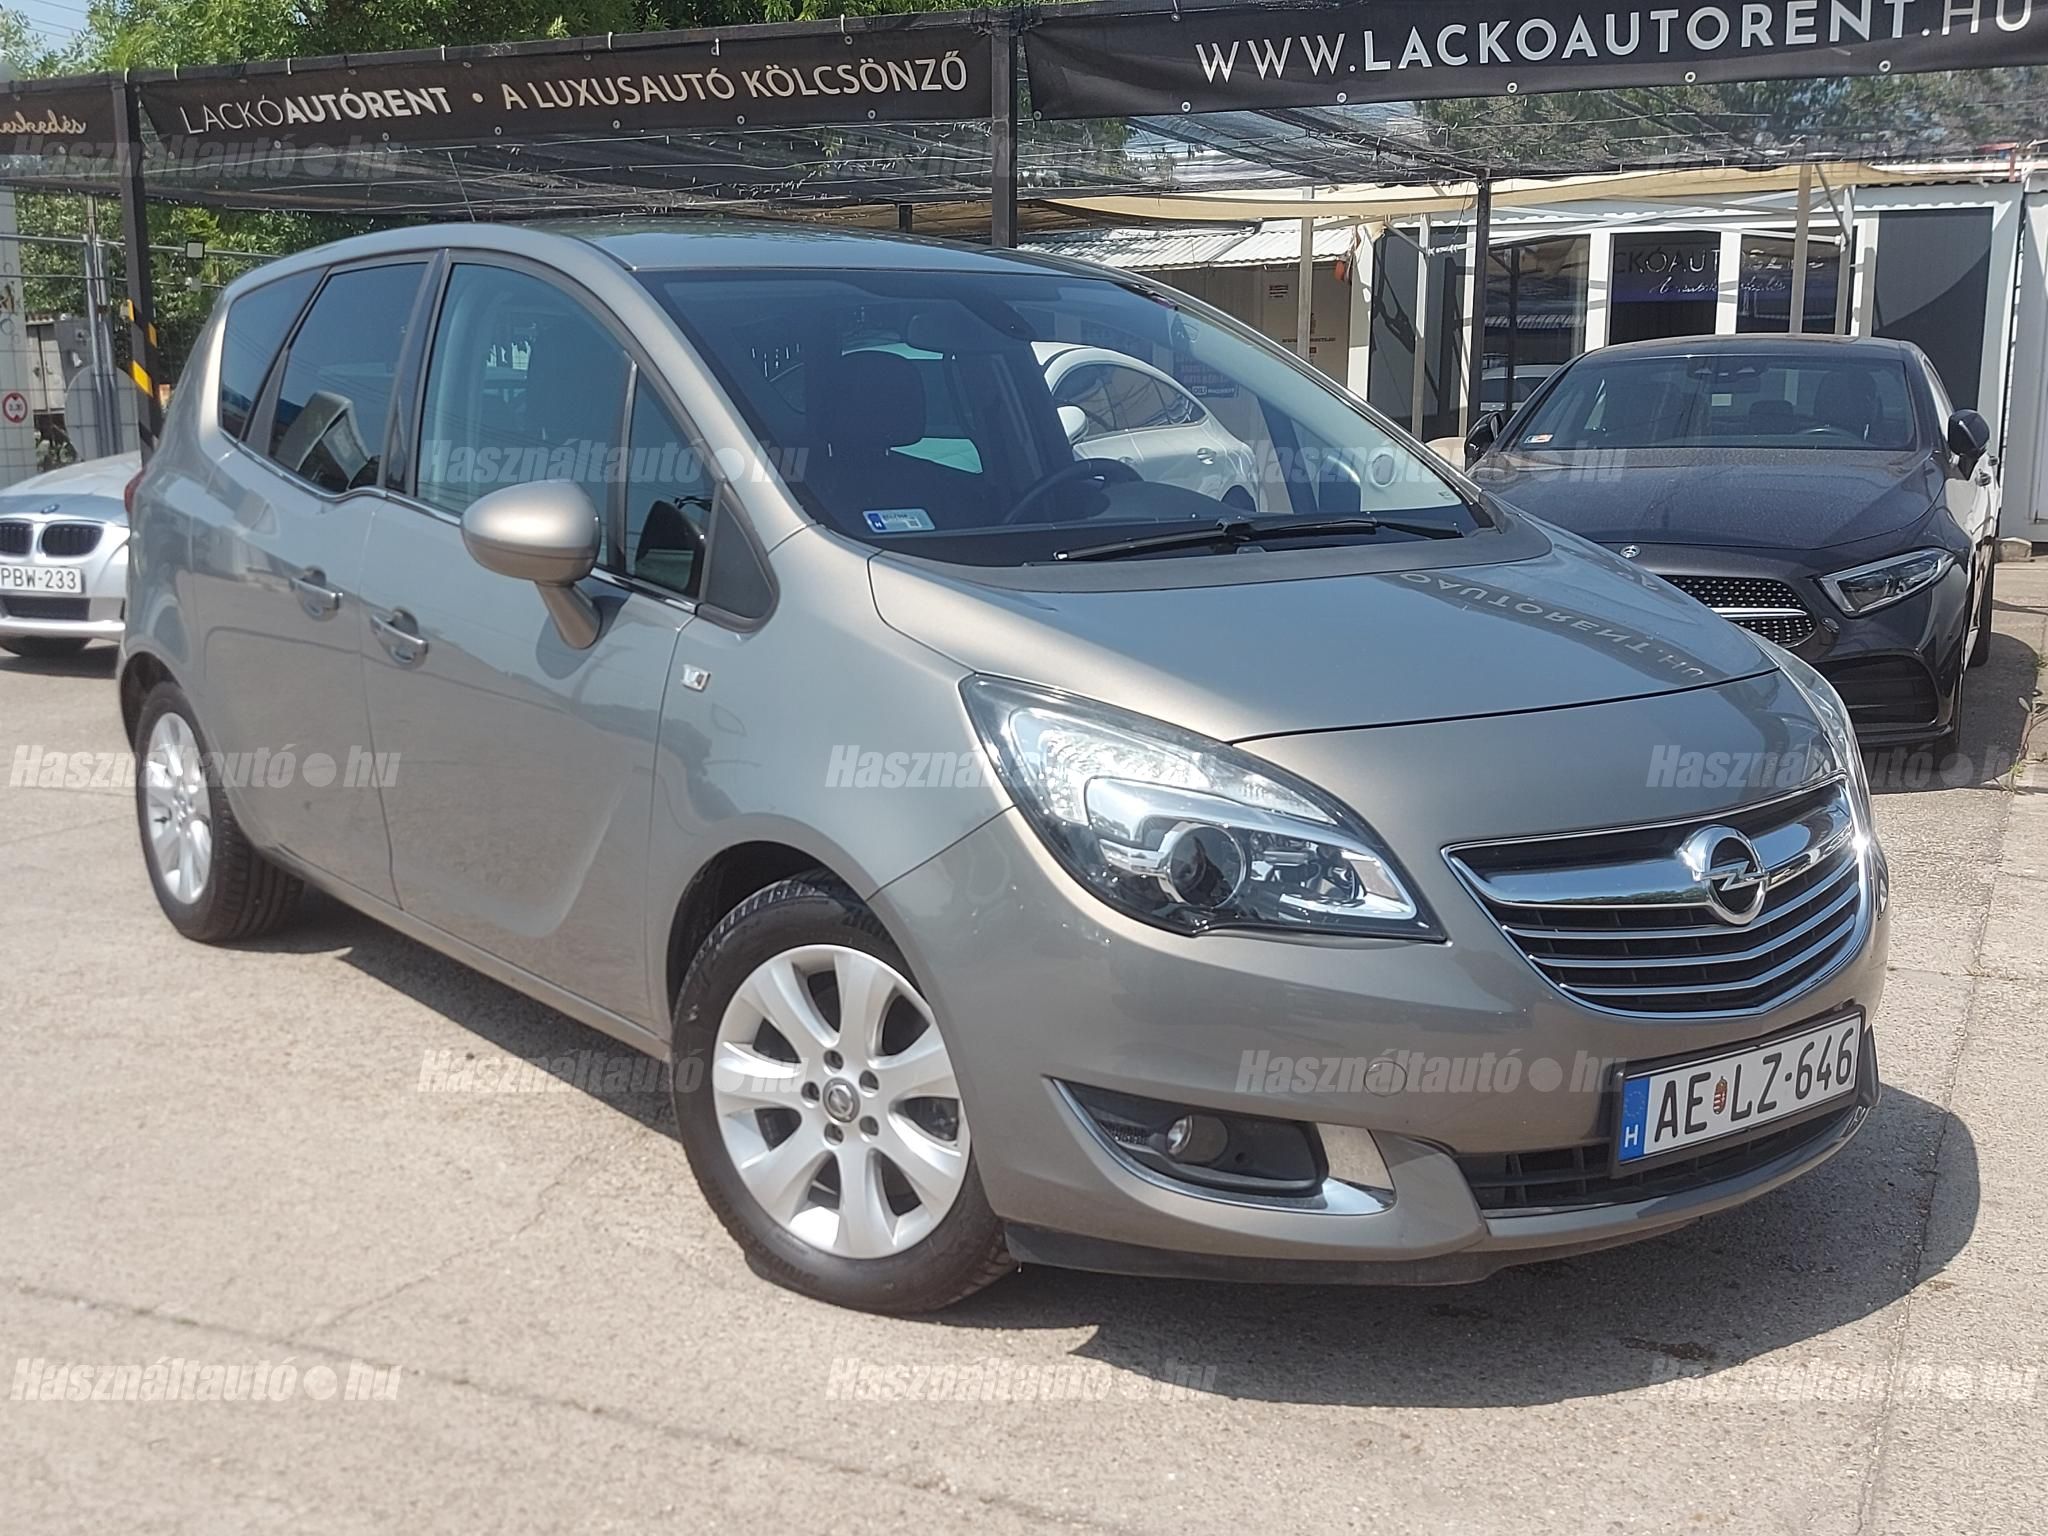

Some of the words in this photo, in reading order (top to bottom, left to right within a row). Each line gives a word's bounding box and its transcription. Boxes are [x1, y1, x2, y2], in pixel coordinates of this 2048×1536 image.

[1196, 0, 2032, 85] WWW.LACKOAUTORENT.HU
[179, 87, 452, 135] LACKÓAUTÓRENT
[501, 83, 528, 110] A
[527, 67, 735, 109] LUXUSAUTÓ
[740, 50, 969, 98] KÖLCSÖNZŐ
[1, 567, 77, 590] PBW-233
[1624, 1123, 1639, 1149] H
[1654, 1071, 1712, 1143] AE
